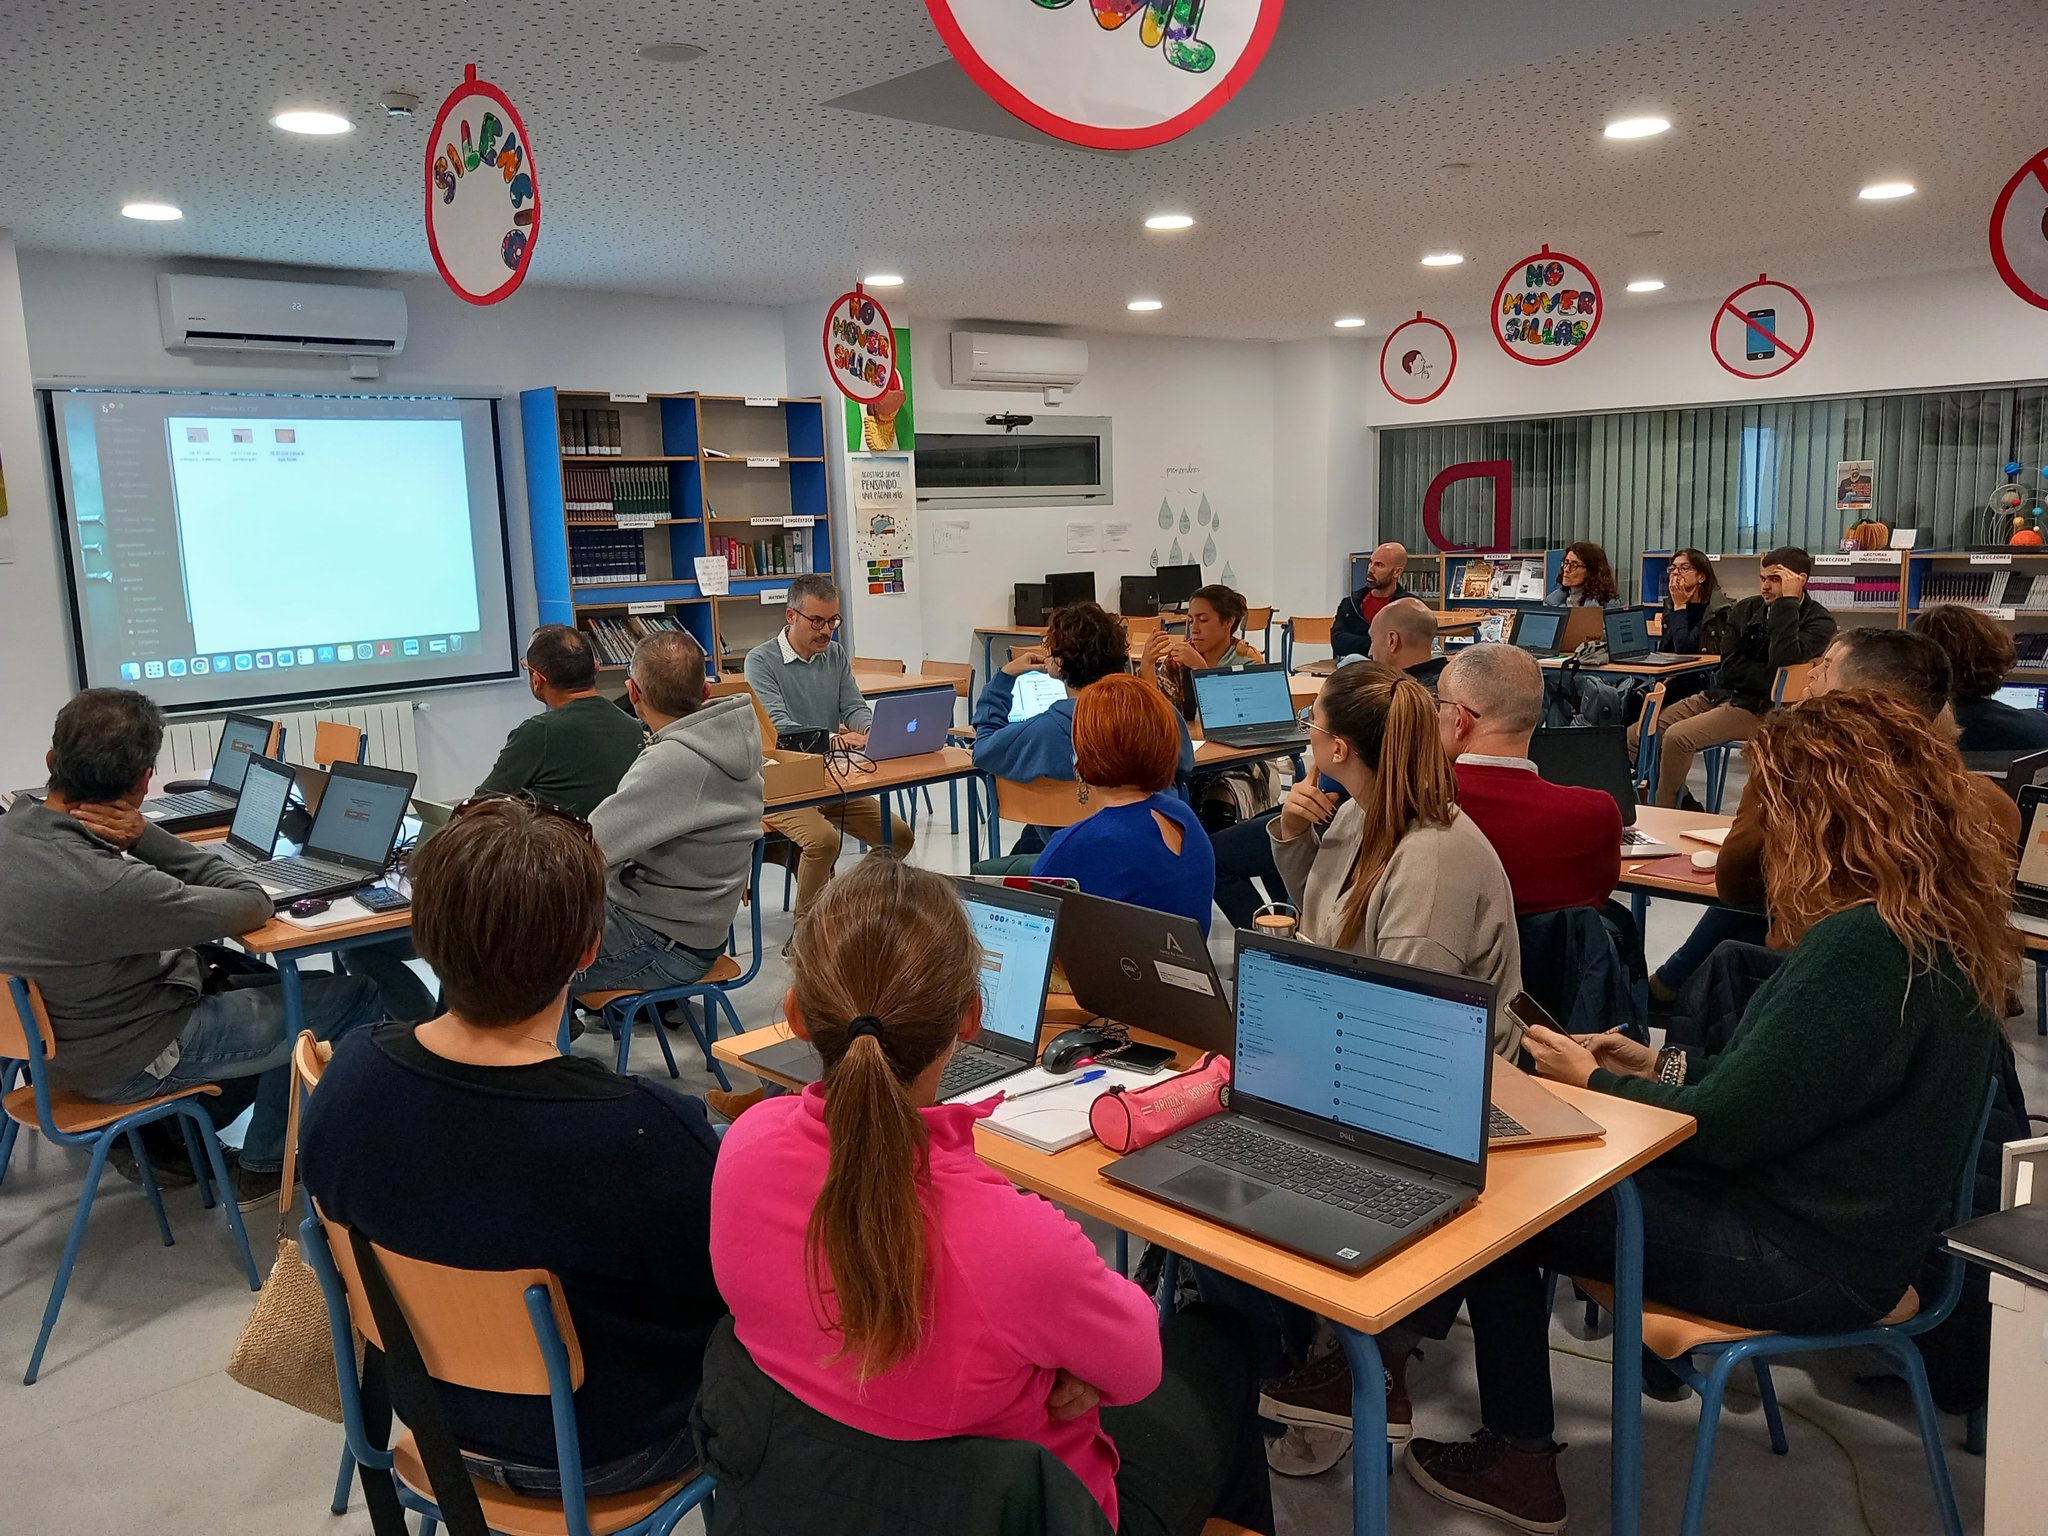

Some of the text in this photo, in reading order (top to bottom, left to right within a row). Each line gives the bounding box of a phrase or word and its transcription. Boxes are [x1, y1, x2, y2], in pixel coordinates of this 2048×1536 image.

[434, 112, 534, 271] SILENCIO
[1525, 261, 1565, 287] NO
[849, 298, 875, 326] NO
[1503, 289, 1596, 316] MOVER
[833, 316, 889, 359] MOVER
[1505, 317, 1588, 346] SILLAS
[834, 344, 886, 388] SILLAS
[1188, 1081, 1216, 1099] BRIDGE
[1339, 1131, 1356, 1143] DELL
